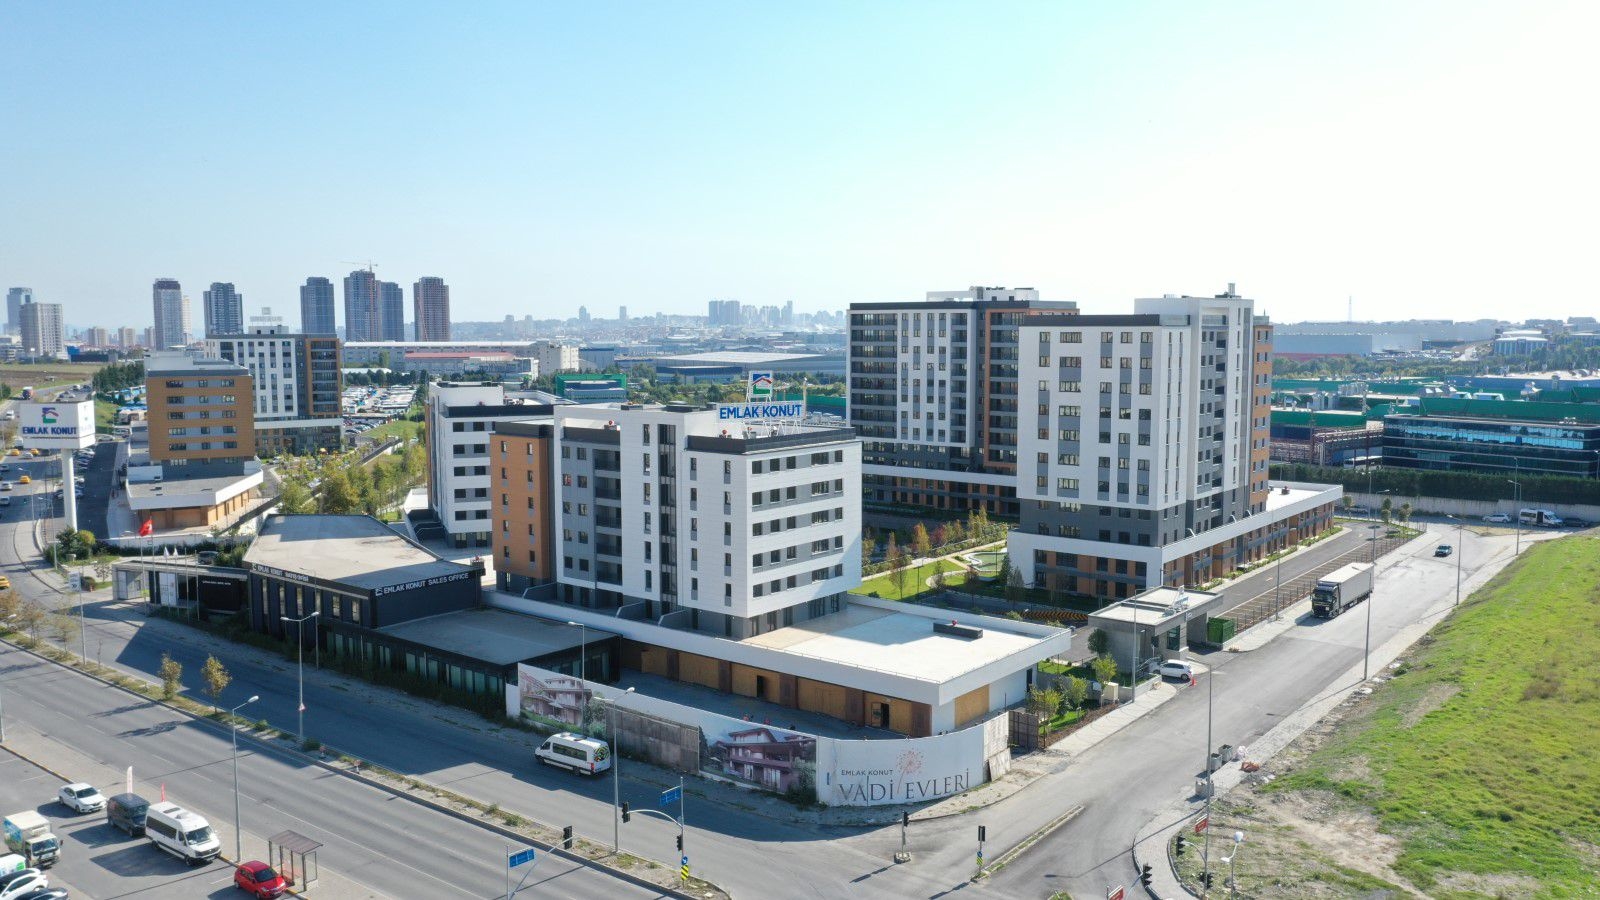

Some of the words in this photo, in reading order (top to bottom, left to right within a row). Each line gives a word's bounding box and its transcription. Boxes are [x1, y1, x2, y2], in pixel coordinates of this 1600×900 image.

[719, 406, 760, 419] EMLAK
[762, 404, 802, 418] KONUT
[22, 426, 49, 435] EMLAK
[51, 426, 77, 435] KONUT
[383, 585, 405, 594] EMLAK
[406, 580, 426, 590] KONUT
[428, 577, 448, 586] SALES
[448, 573, 469, 582] OFFICE
[839, 779, 894, 801] VADİ
[905, 768, 970, 799] EVLERİ
